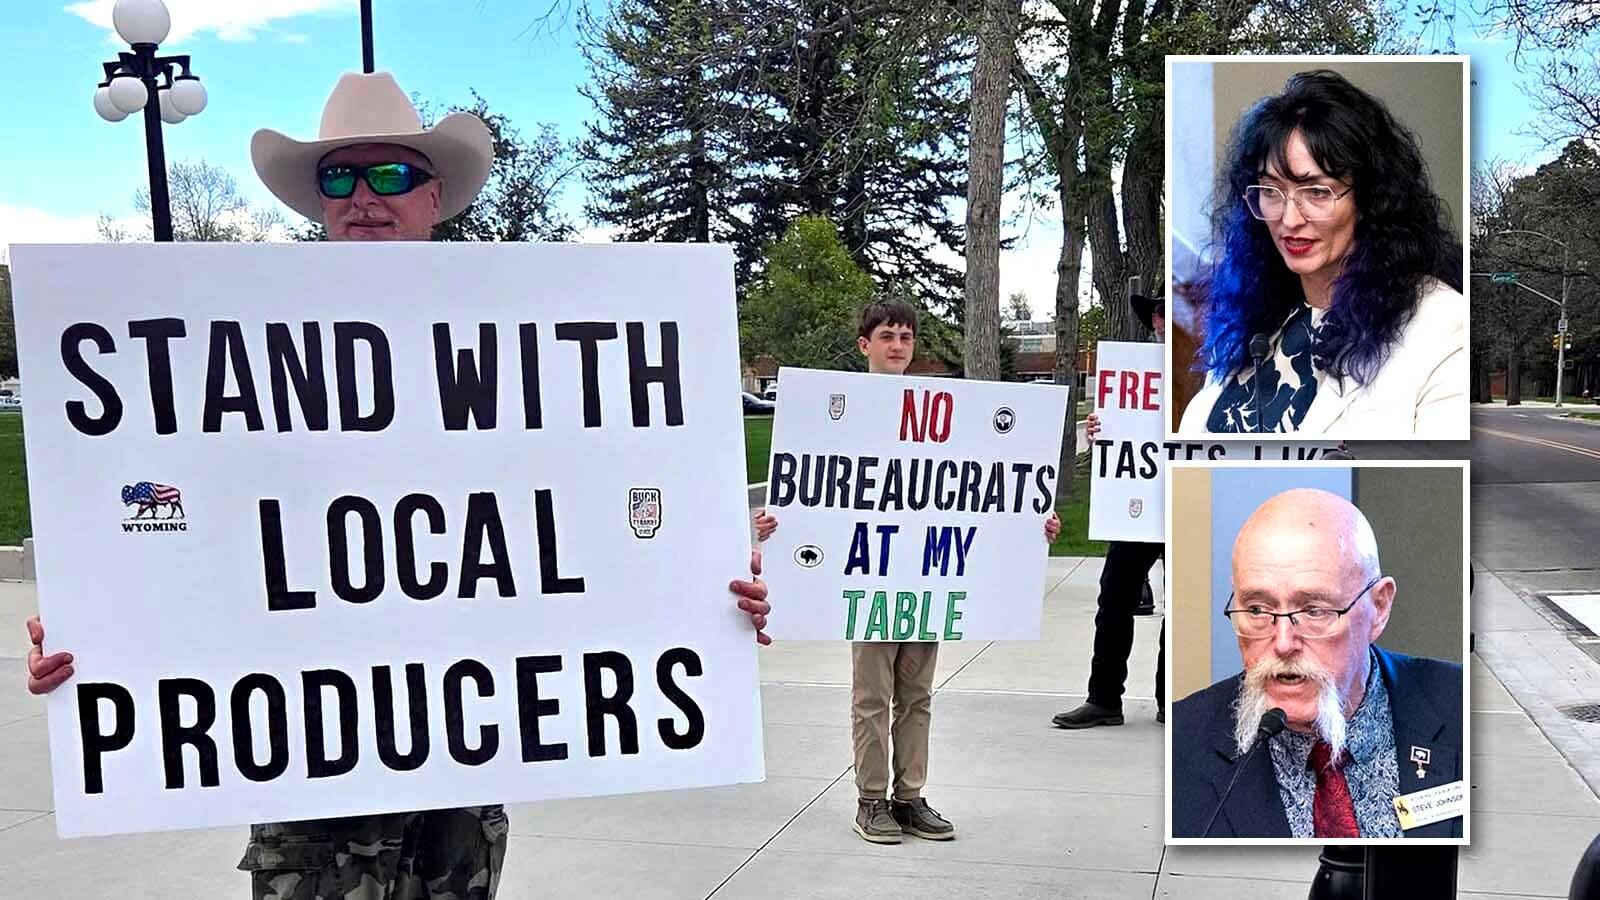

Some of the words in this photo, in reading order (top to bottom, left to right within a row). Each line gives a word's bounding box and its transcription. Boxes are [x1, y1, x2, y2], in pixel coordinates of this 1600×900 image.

[60, 317, 396, 436] STAND
[432, 321, 684, 431] WITH
[899, 388, 954, 443] NO
[632, 491, 657, 503] BUCK
[769, 452, 1056, 515] BUREAUCRATS
[121, 522, 187, 533] WYOMING
[258, 488, 586, 612] LOCAL
[843, 522, 900, 577] AT
[921, 526, 978, 577] MY
[842, 589, 967, 641] TABLE
[76, 647, 705, 795] PRODUCERS
[1413, 802, 1434, 813] STEVE
